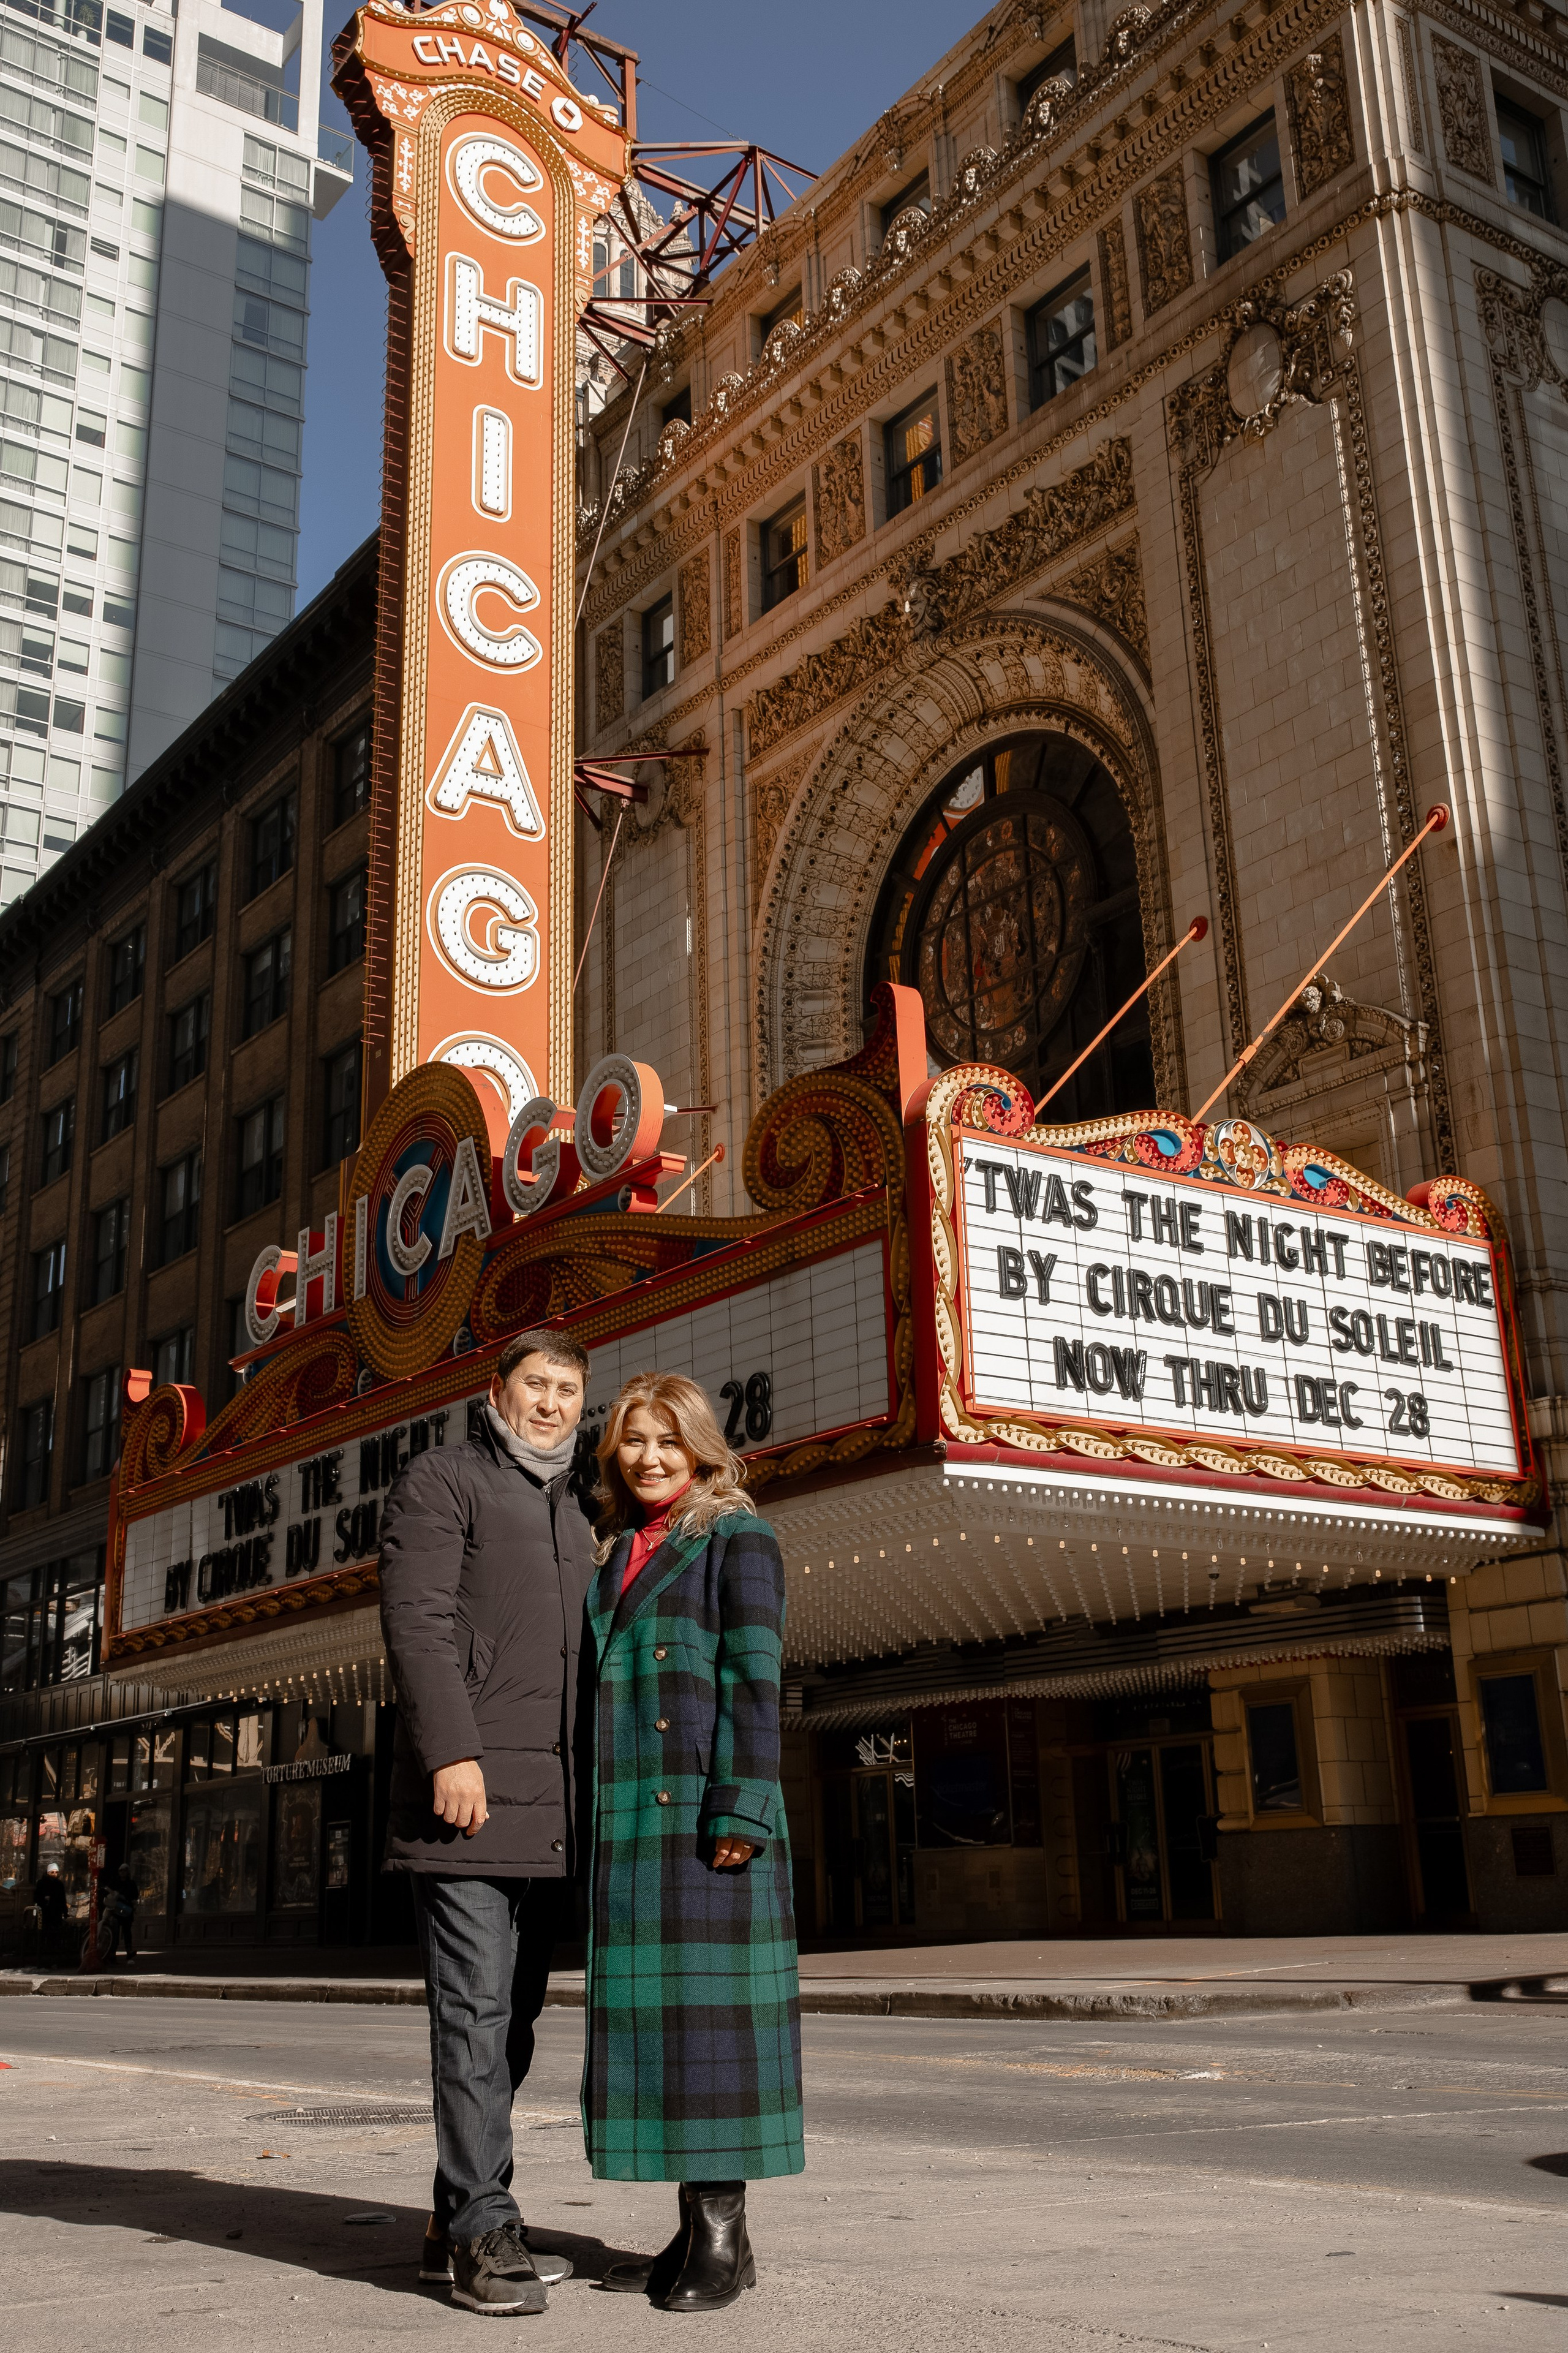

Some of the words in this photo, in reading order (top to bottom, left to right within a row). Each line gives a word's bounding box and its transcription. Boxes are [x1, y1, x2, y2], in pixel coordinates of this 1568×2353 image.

[412, 35, 548, 101] CHASE
[244, 1052, 655, 1346] CHICAGO
[963, 1156, 1098, 1231] 'TWAS
[1122, 1188, 1204, 1255] THE
[1226, 1209, 1349, 1279] NIGHT
[1367, 1239, 1495, 1309] BEFORE
[997, 1245, 1058, 1305] BY
[1085, 1263, 1235, 1336] CIRQUE
[1257, 1292, 1310, 1346] DU
[1330, 1305, 1454, 1372] SOLEIL
[1054, 1335, 1147, 1401] NOW
[1164, 1353, 1269, 1418] THRU
[1294, 1373, 1364, 1431] DEC
[1387, 1386, 1431, 1439] 28
[164, 1559, 192, 1614] BY
[197, 1532, 273, 1604] CIRQUE
[285, 1517, 322, 1578] DU
[719, 1371, 772, 1449] 28
[297, 1448, 344, 1515] THE
[260, 1762, 305, 1785] TORTURE
[306, 1753, 352, 1778] MUSEUM
[948, 1721, 978, 1732] CHICAGO
[949, 1729, 978, 1739] THEATRE
